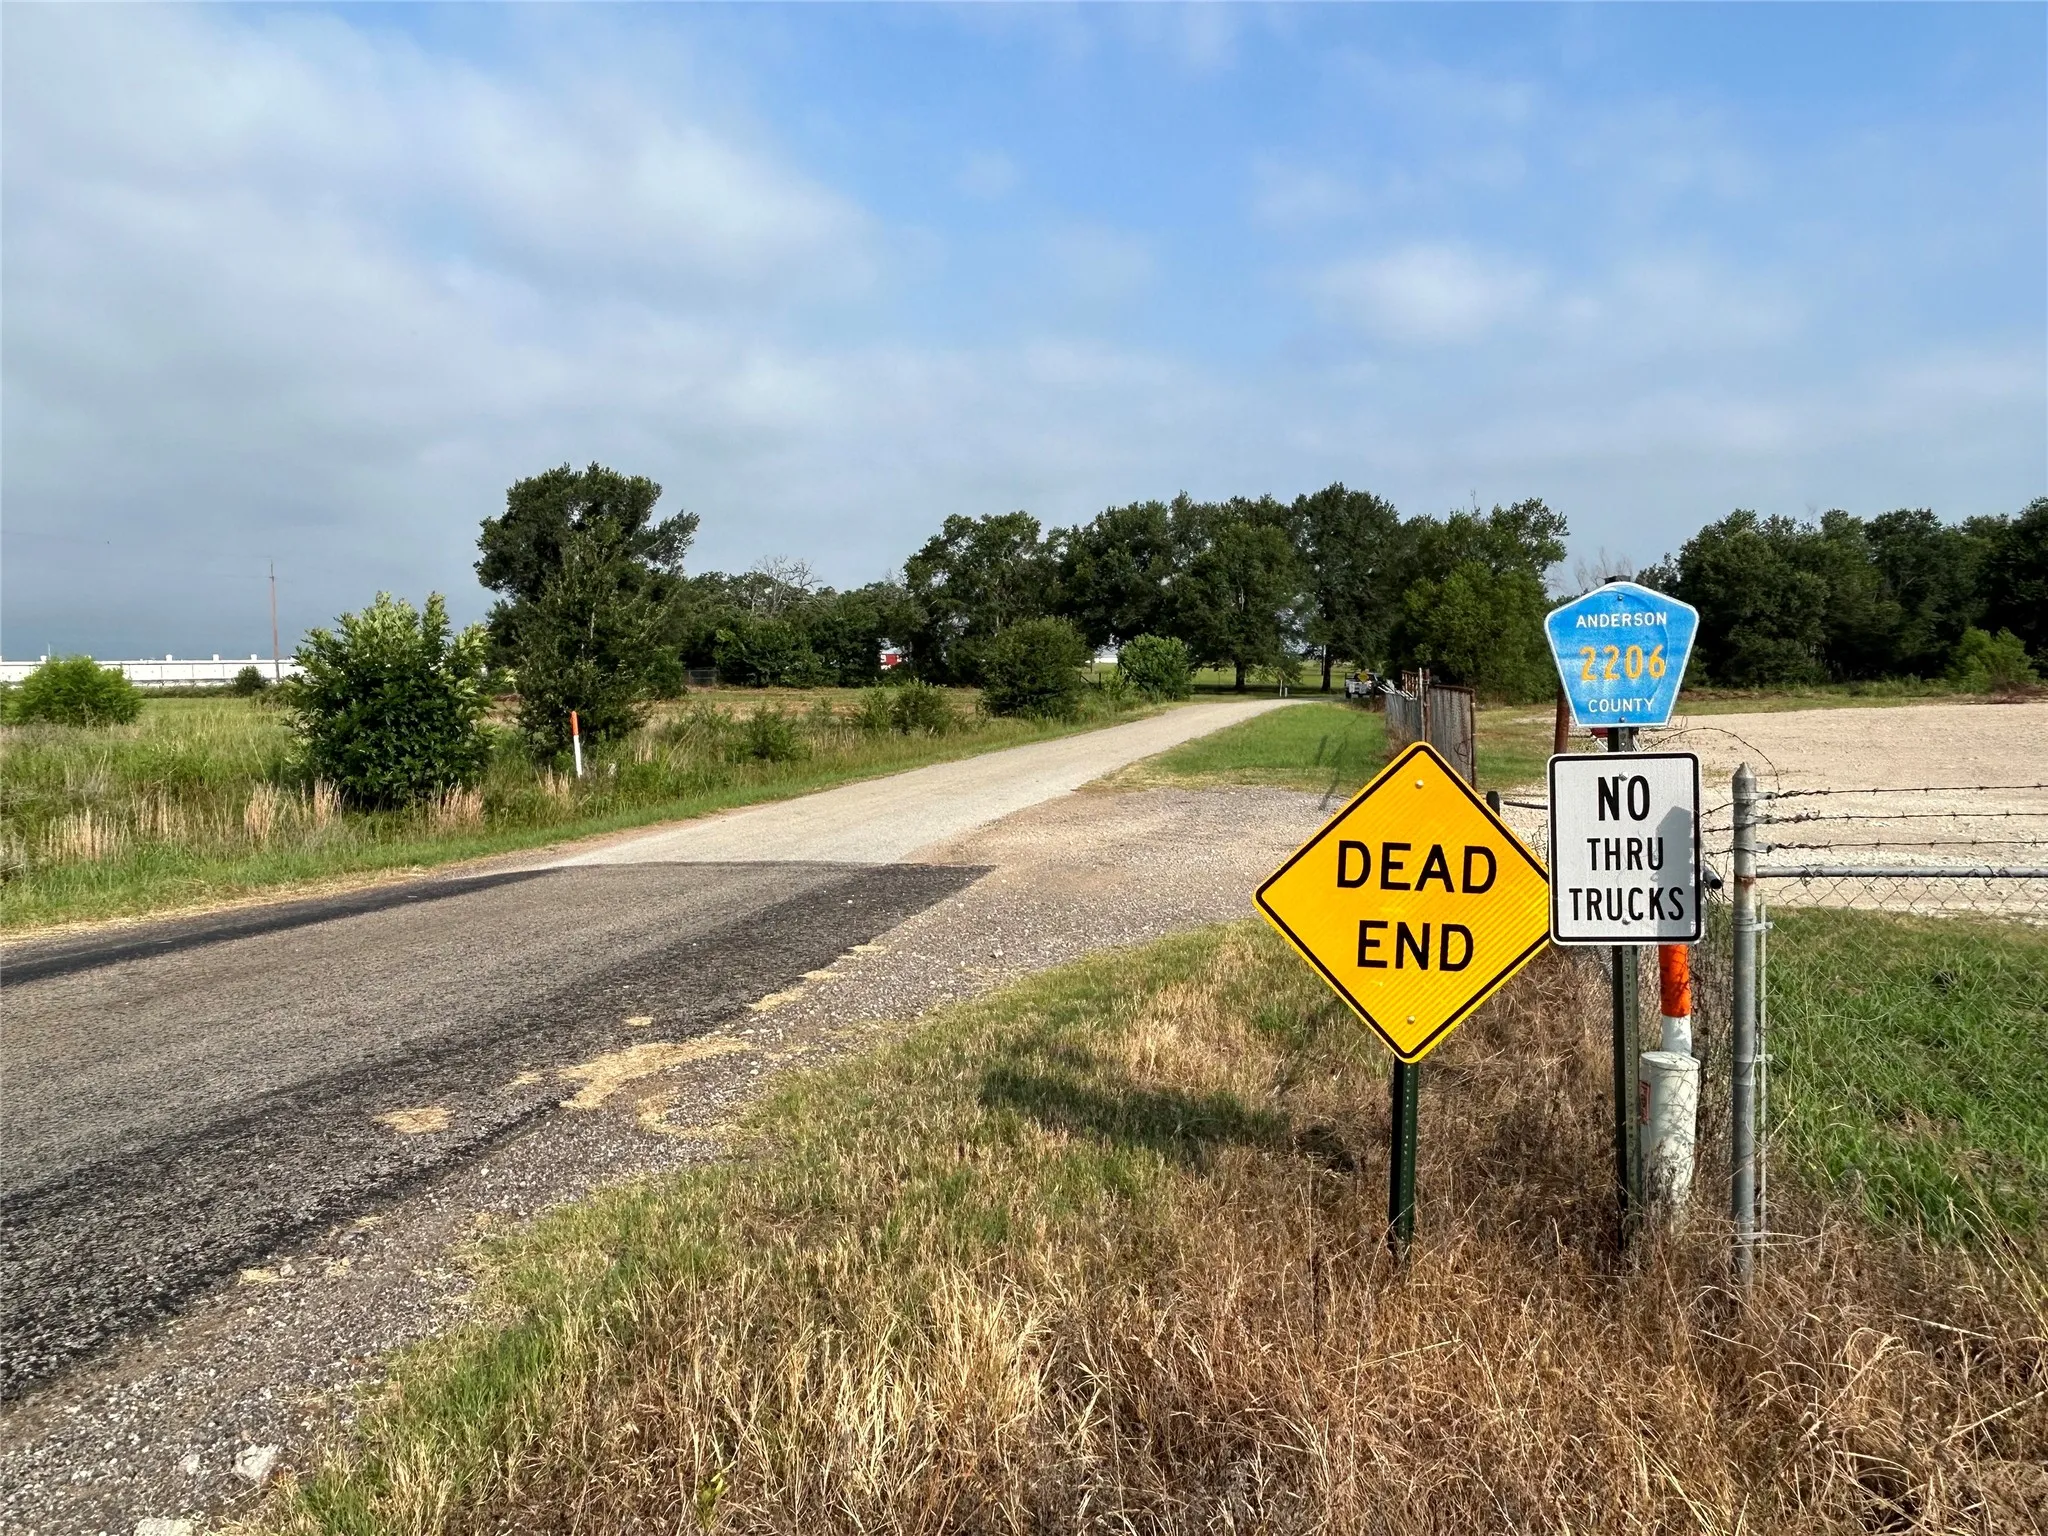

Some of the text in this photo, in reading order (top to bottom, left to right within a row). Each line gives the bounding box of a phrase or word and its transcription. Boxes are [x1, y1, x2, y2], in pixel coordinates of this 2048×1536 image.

[1576, 612, 1667, 629] ANDERSON
[1579, 644, 1666, 682] 2206
[1588, 698, 1656, 713] COUNTY
[1597, 775, 1650, 821] NO
[1336, 840, 1497, 894] DEAD
[1587, 837, 1664, 871] THRU
[1568, 887, 1684, 921] TRUCKS
[1357, 920, 1474, 972] END
